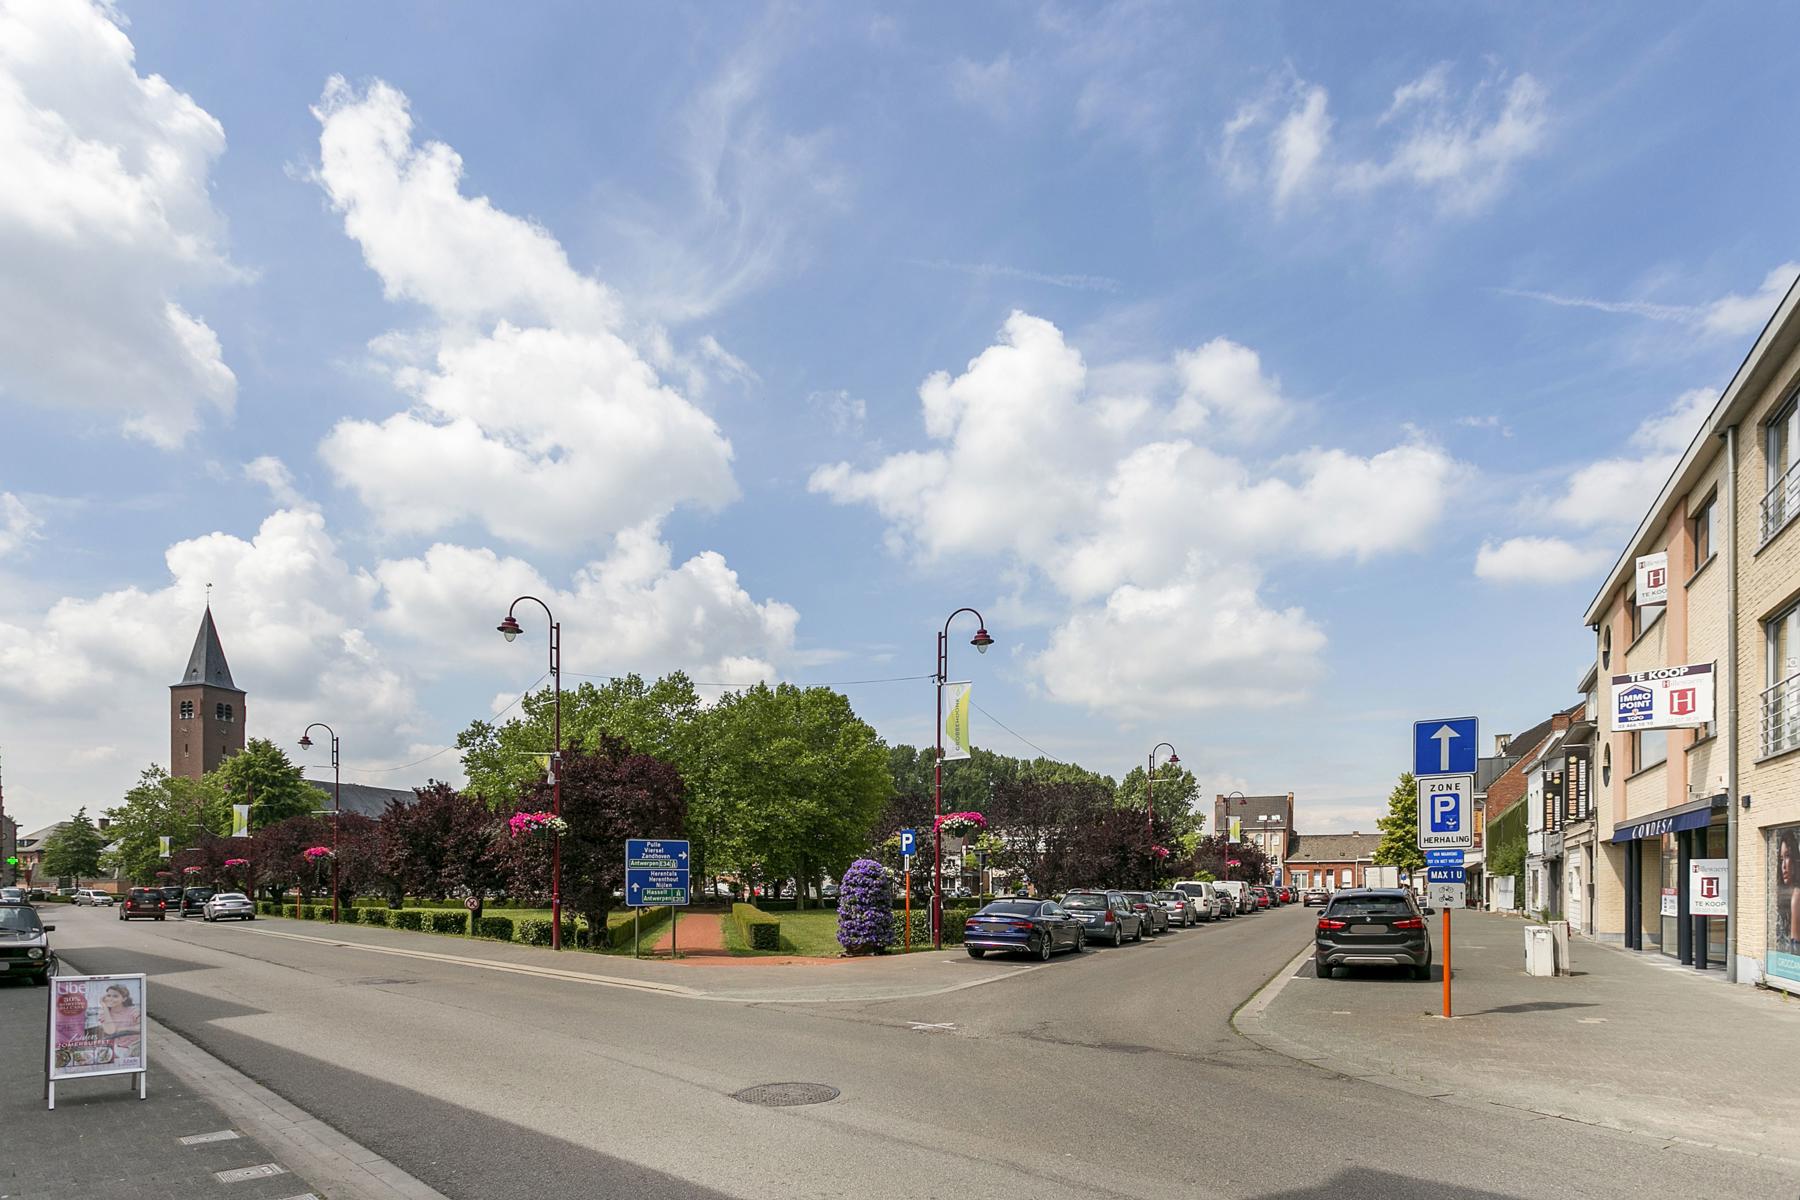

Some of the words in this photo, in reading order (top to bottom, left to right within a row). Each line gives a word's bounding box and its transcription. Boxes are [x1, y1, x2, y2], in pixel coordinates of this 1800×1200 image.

[1629, 673, 1645, 682] TE
[1648, 667, 1689, 680] KOOP
[1620, 693, 1651, 702] IMMO
[1620, 700, 1651, 710] POINT
[1672, 690, 1694, 712] H
[1569, 764, 1577, 780] MAAN
[1430, 783, 1461, 792] ZONE
[1569, 782, 1577, 799] HALVE
[1435, 797, 1456, 823] P
[1632, 818, 1673, 839] CONDESA
[902, 833, 913, 851] P
[1423, 835, 1470, 844] HERHALING
[1431, 871, 1448, 879] MAX
[1456, 871, 1463, 879] U
[1702, 879, 1718, 896] H
